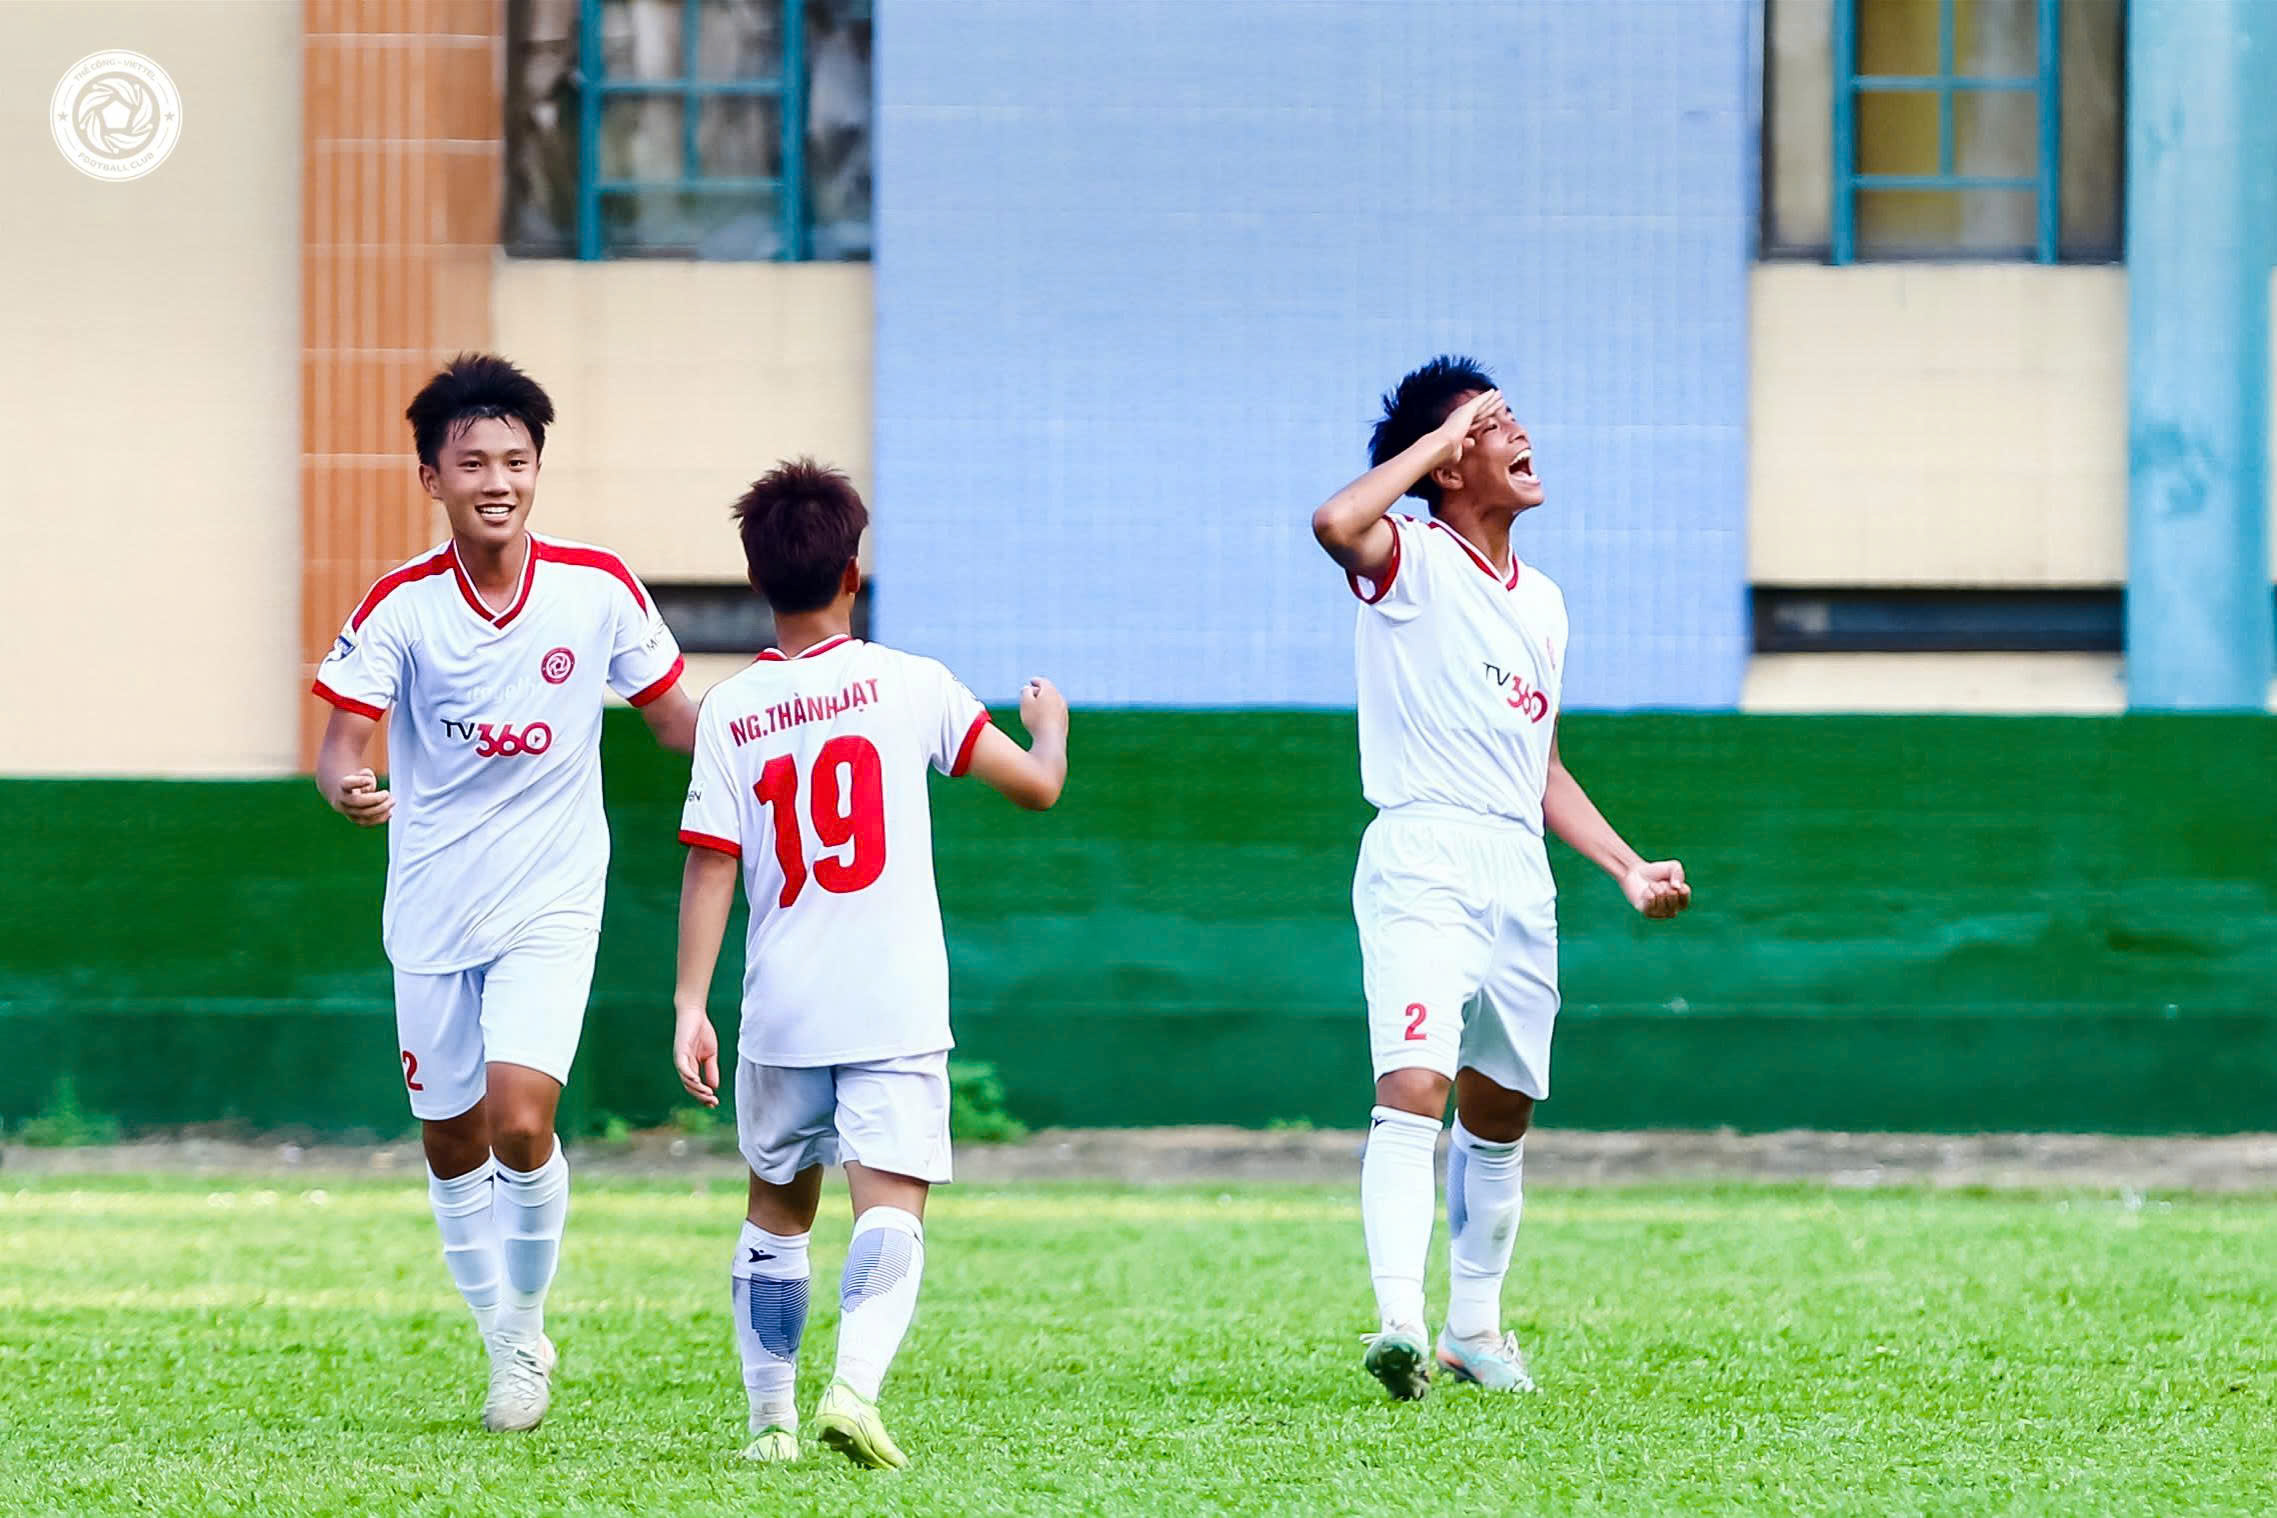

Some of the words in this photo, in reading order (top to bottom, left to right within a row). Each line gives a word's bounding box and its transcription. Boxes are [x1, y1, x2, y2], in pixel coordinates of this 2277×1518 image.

[440, 718, 553, 758] TV360
[752, 734, 887, 909] 19
[1404, 1002, 1428, 1041] 2
[402, 1050, 424, 1092] 2
